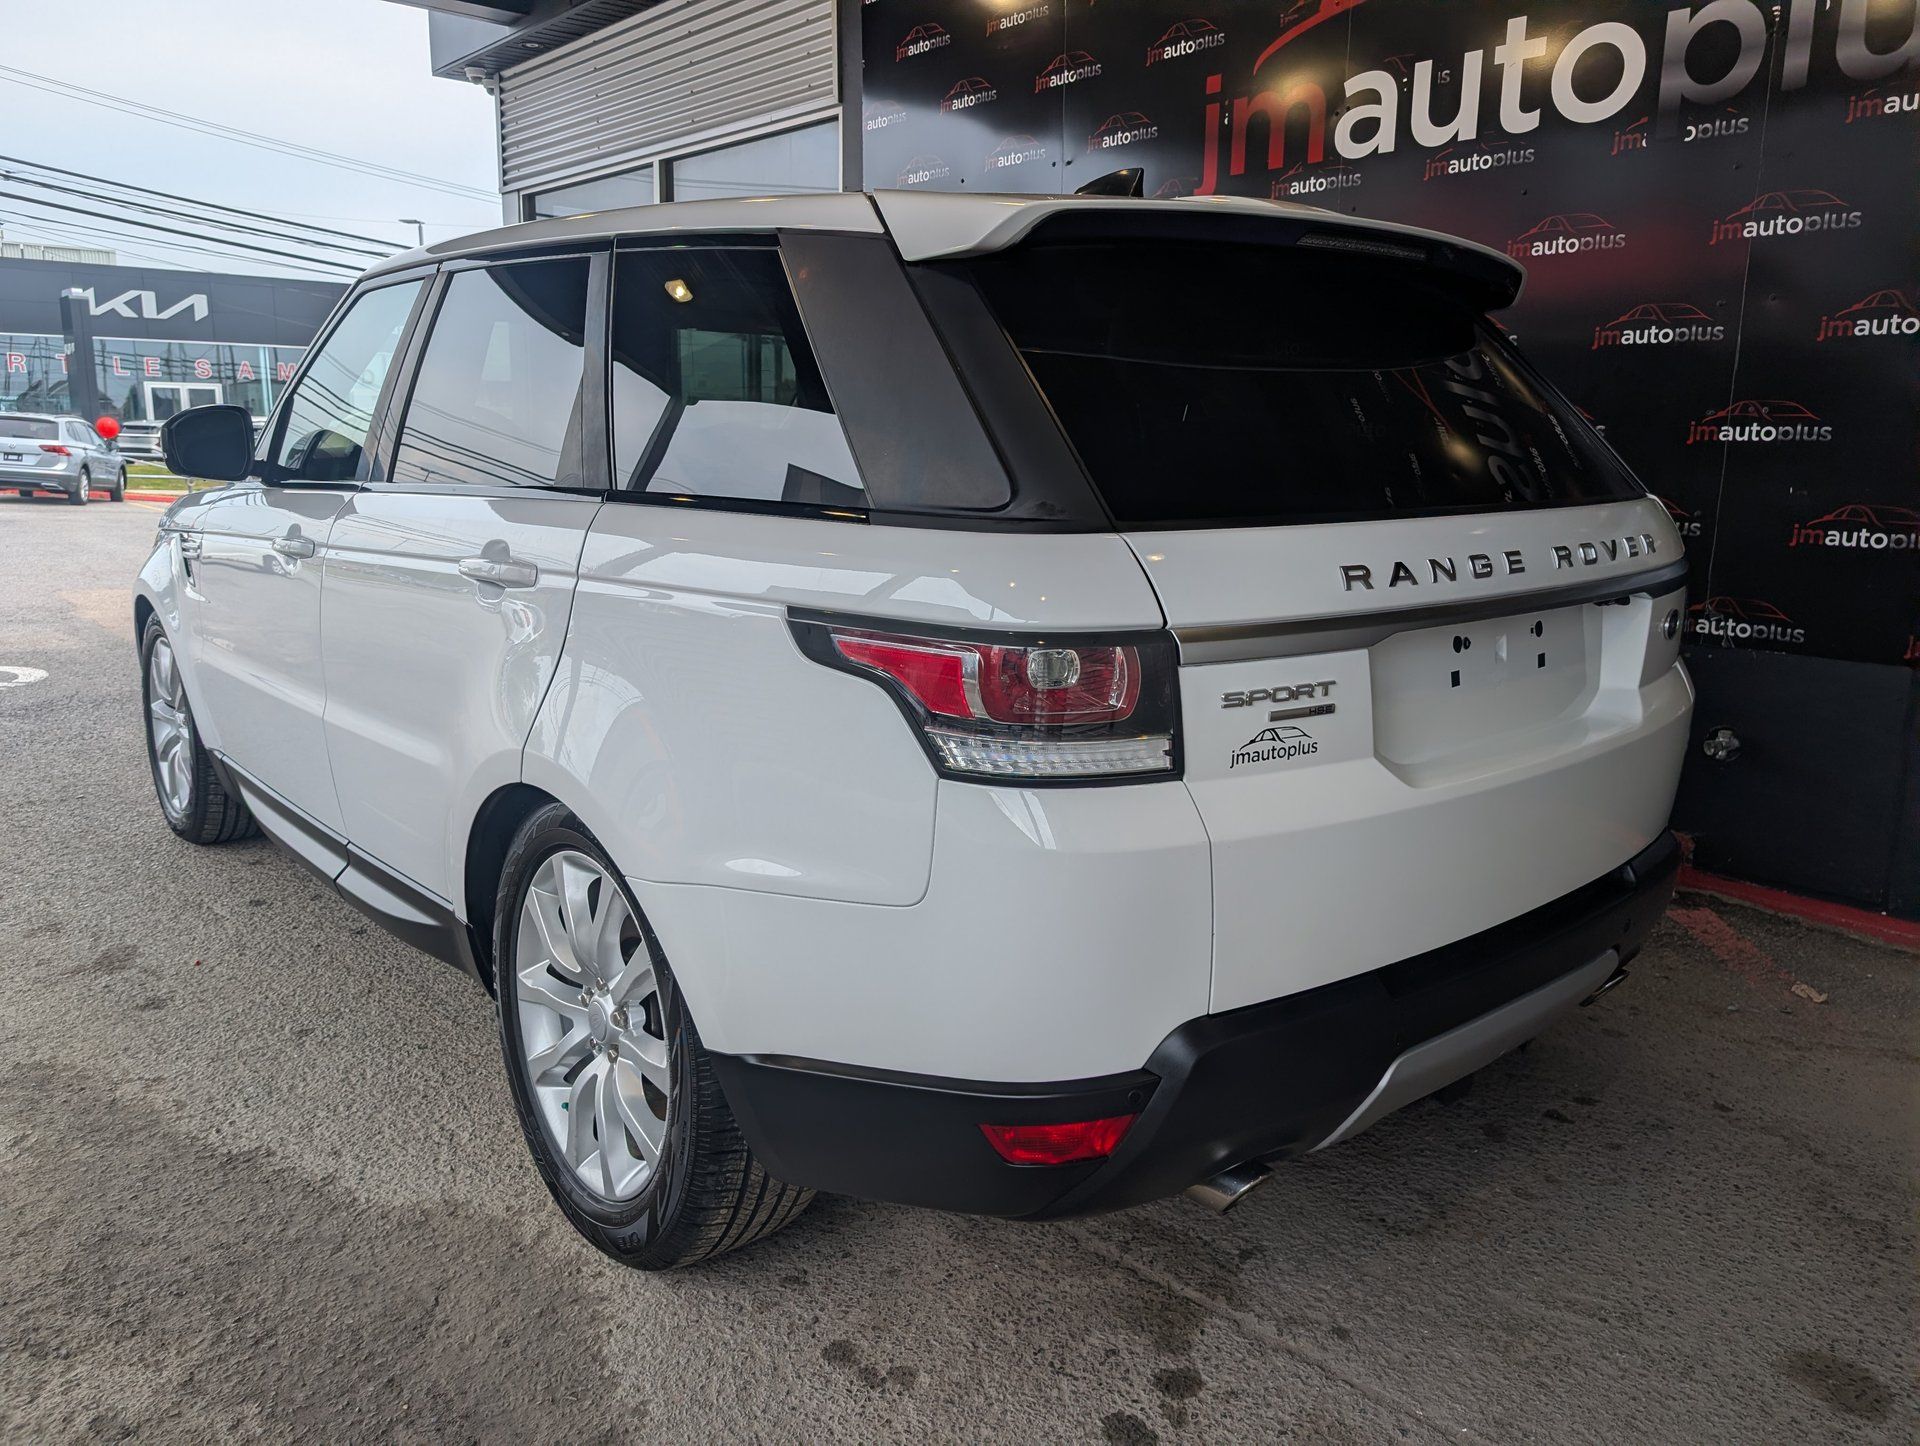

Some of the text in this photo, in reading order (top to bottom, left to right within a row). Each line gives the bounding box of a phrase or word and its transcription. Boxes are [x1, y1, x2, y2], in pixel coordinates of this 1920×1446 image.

[986, 5, 1049, 38] jmautoplus
[896, 34, 951, 63] jmautoplus
[1146, 31, 1225, 68] jmautoplus
[1035, 62, 1101, 94] jmautoplus
[940, 89, 997, 117] jmautoplus
[1087, 124, 1158, 155] jmautoplus
[984, 148, 1046, 173] jmautoplus
[1424, 147, 1535, 181] jmautoplus
[1270, 171, 1361, 200] jmautoplus
[1710, 208, 1862, 245] jmautoplus
[1507, 231, 1626, 257] jmautoplus
[1592, 323, 1725, 350] jmautoplus
[1686, 420, 1832, 445] jmautoplus
[1338, 533, 1657, 592] RANGE ROVER
[1220, 680, 1337, 709] SPORT
[1308, 703, 1335, 716] HSE
[1229, 740, 1318, 769] jmautoplus
